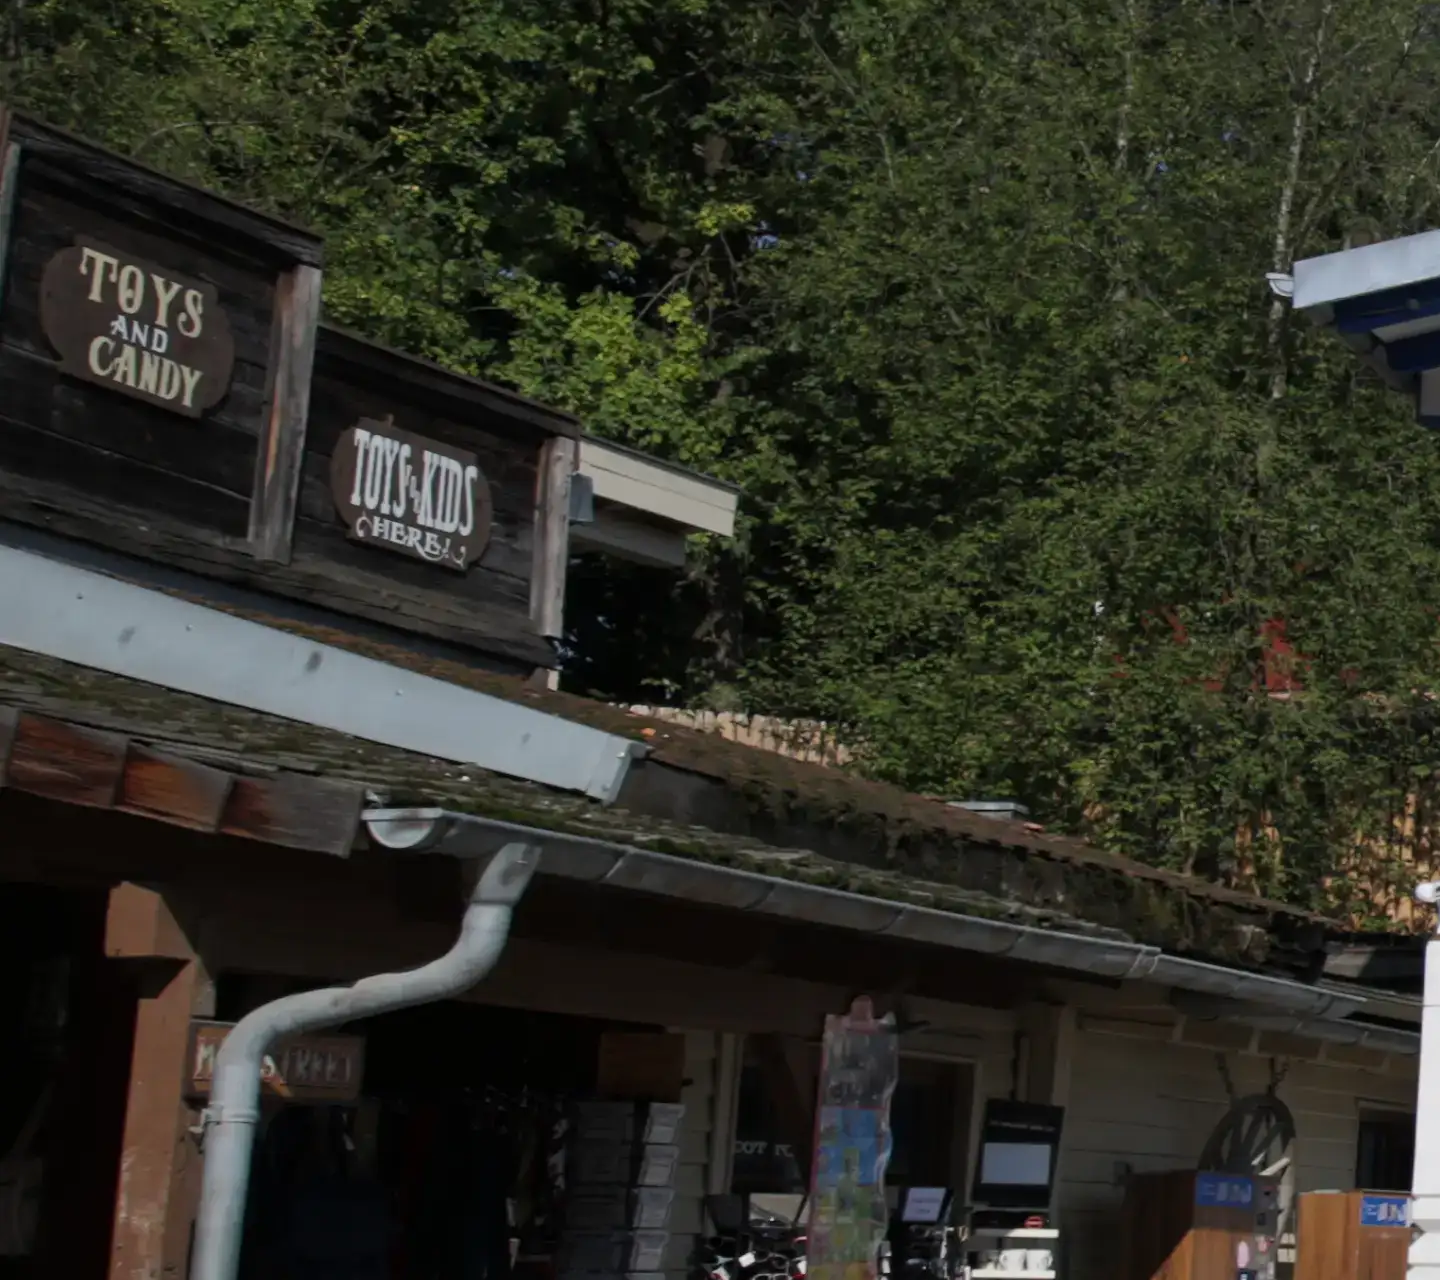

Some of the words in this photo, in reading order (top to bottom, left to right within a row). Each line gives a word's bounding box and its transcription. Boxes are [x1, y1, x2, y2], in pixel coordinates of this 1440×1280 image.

[79, 246, 203, 338] TOYS
[110, 314, 169, 354] AND
[88, 335, 203, 408] CANDY
[350, 428, 412, 518] TOYS
[416, 450, 478, 537] KIDS
[371, 515, 452, 561] HERE!
